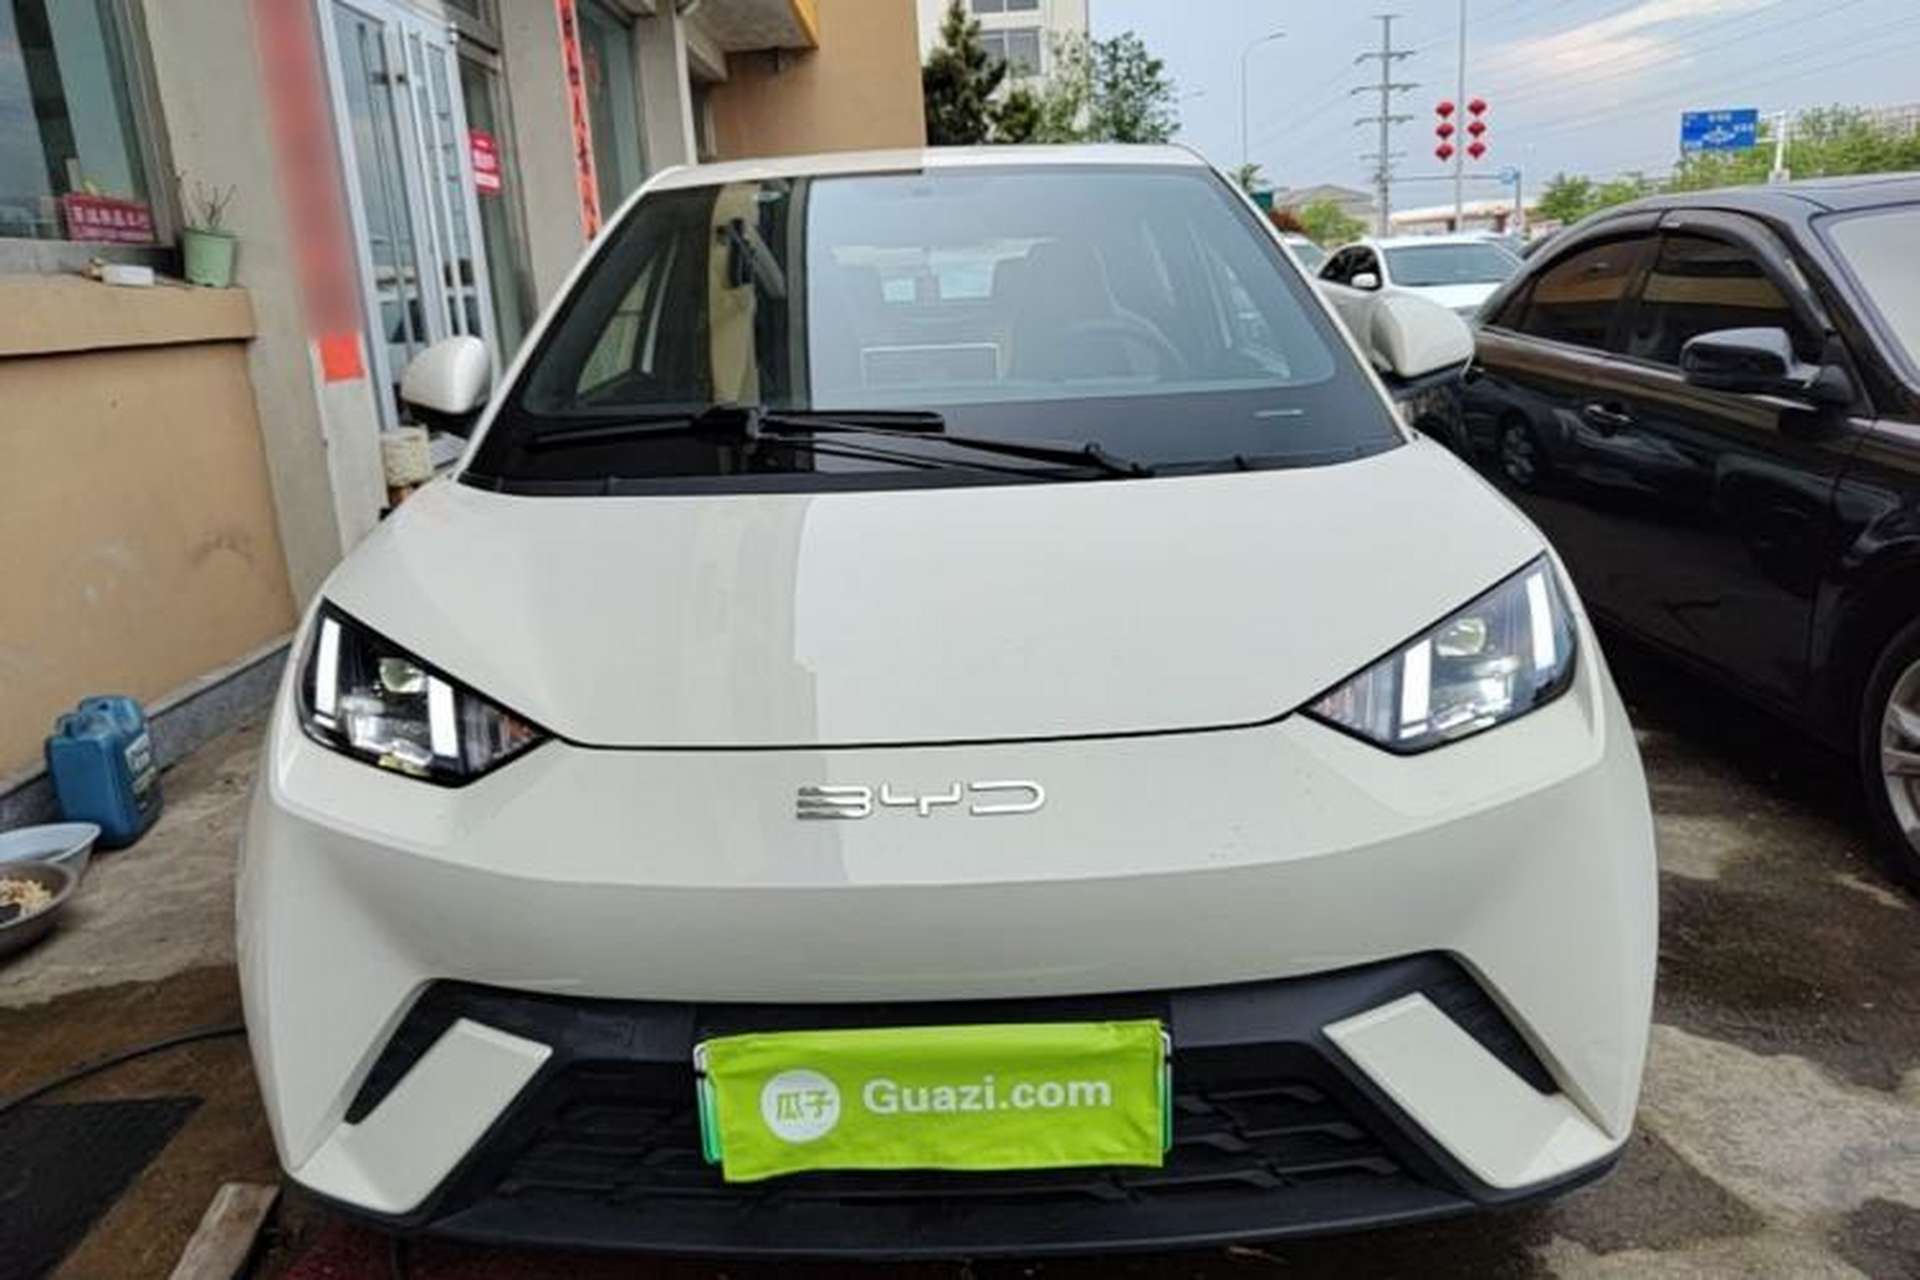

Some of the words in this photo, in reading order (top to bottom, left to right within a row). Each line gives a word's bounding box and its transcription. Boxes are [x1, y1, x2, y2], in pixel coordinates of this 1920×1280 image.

[797, 780, 1045, 820] BYD
[776, 1090, 832, 1121] 瓜子
[863, 1075, 1112, 1114] Guazi.com
